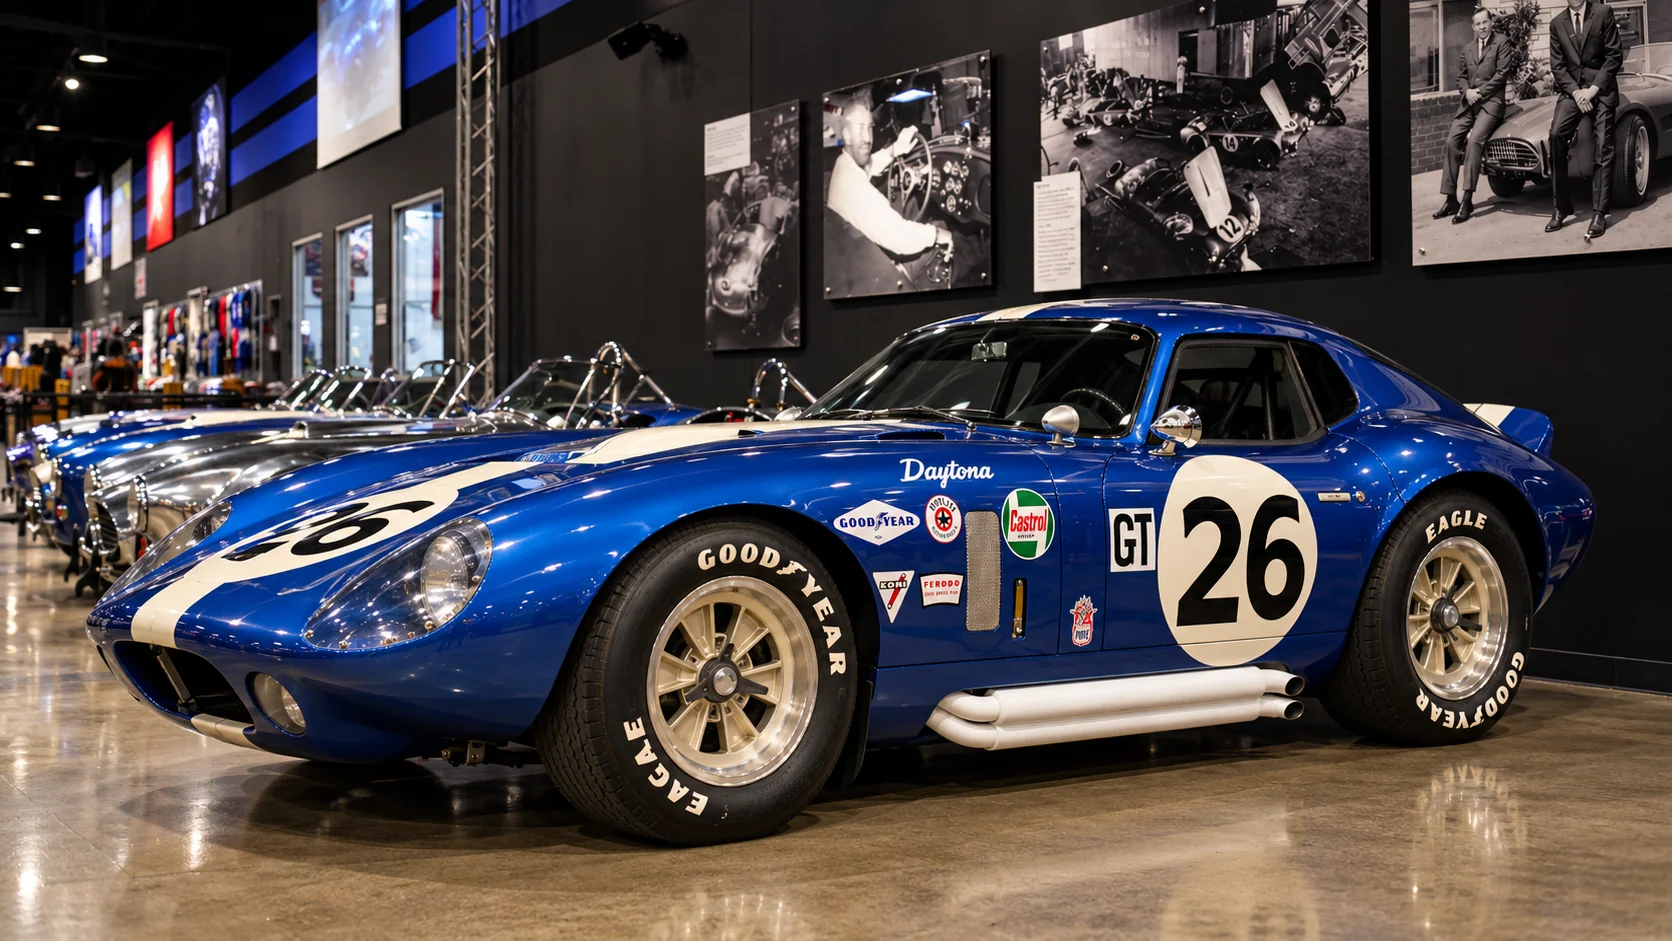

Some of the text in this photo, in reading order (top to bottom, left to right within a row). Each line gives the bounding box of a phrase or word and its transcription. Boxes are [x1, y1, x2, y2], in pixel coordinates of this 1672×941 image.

[1220, 218, 1240, 239] 12
[899, 458, 995, 488] Daytona
[1010, 508, 1047, 532] Castrol
[1425, 509, 1488, 544] EAGLE
[1113, 513, 1152, 567] GT
[1177, 494, 1305, 627] 26
[880, 580, 907, 589] KONI
[924, 580, 960, 588] FERODO
